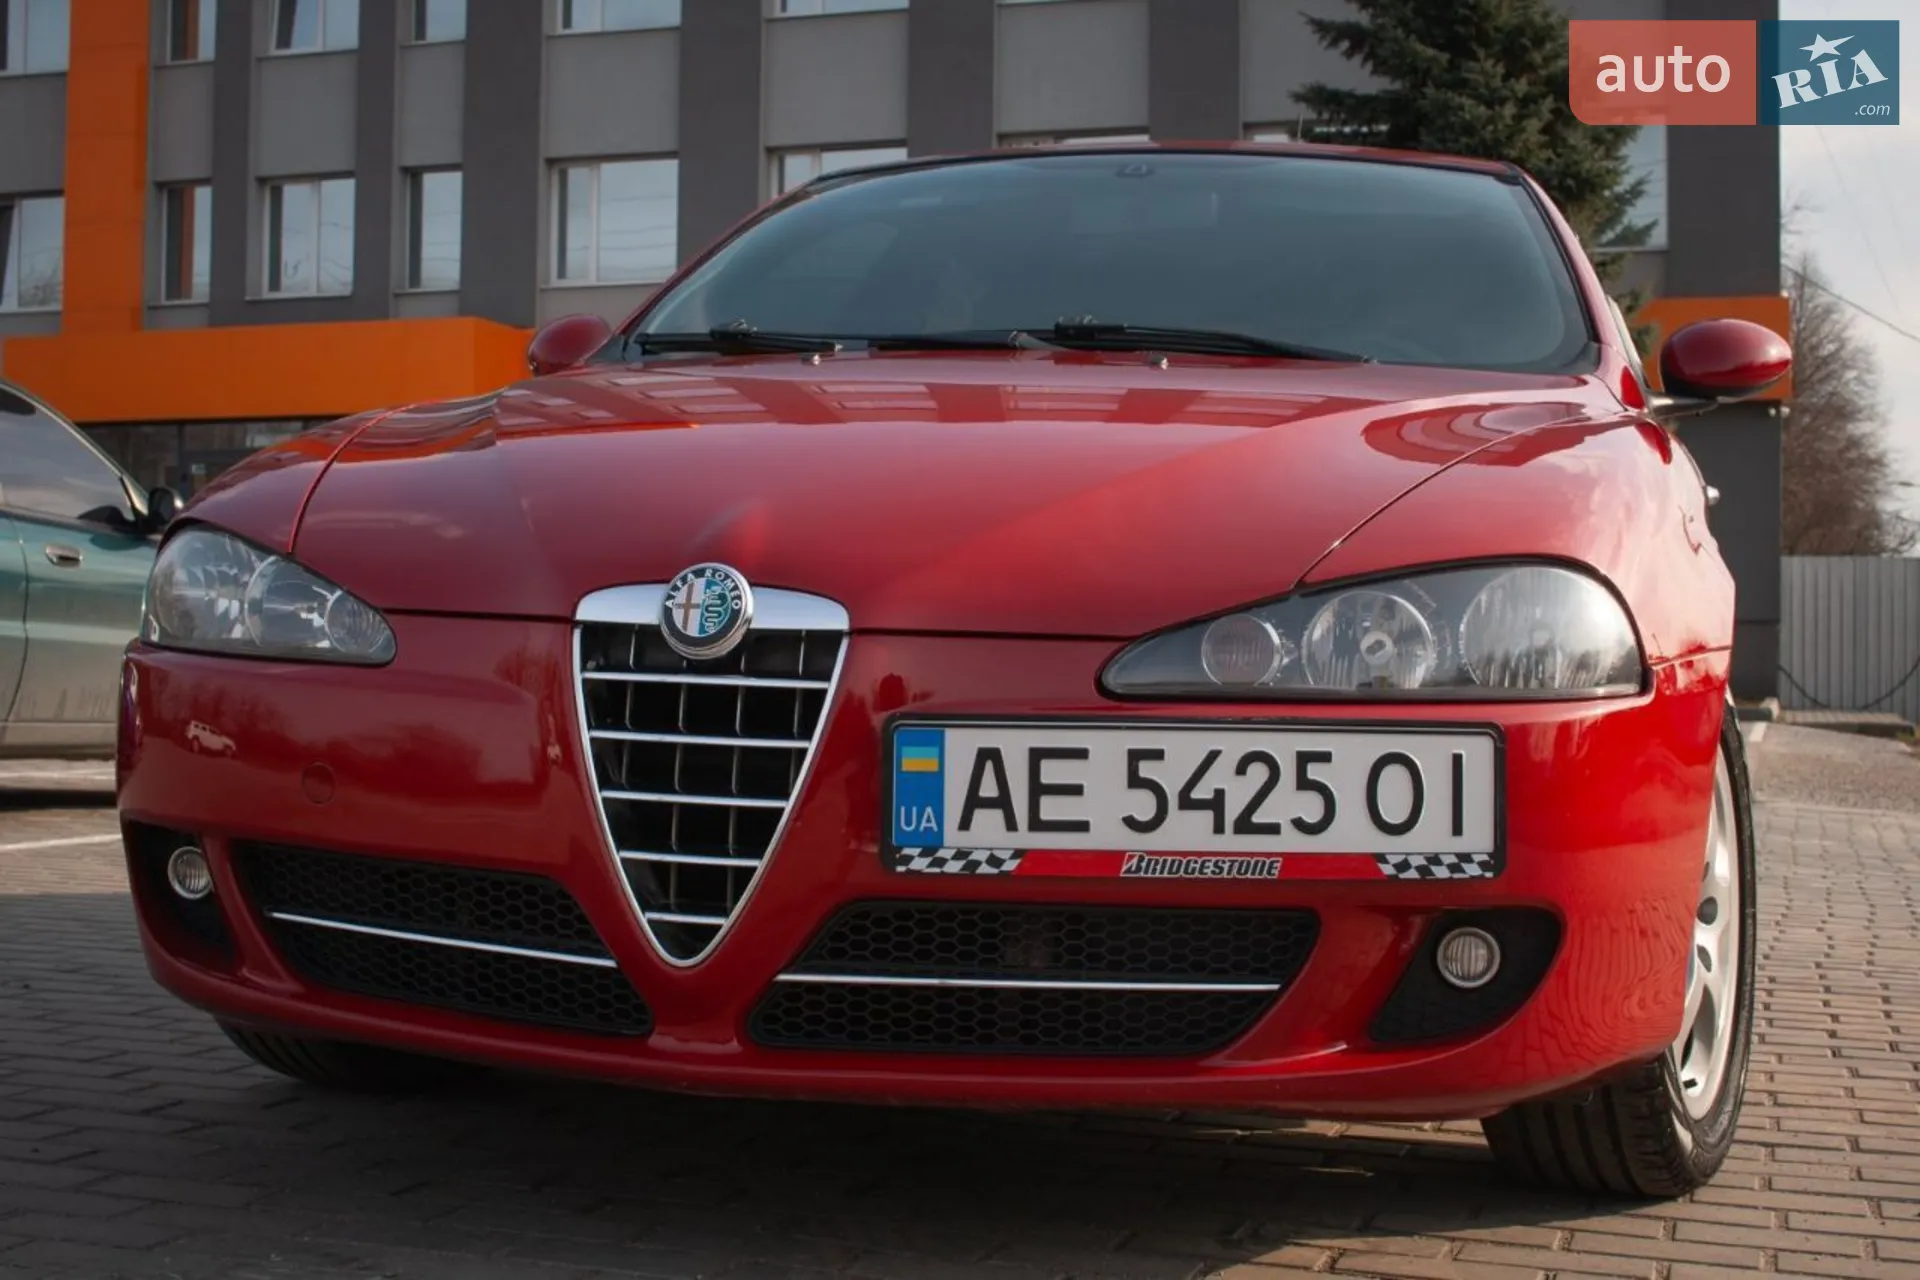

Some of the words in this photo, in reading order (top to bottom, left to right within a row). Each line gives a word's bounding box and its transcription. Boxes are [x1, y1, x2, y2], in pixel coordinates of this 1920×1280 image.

[664, 573, 696, 608] ALFA
[704, 568, 742, 610] ROMEO
[957, 746, 1091, 833] AE
[1120, 748, 1337, 835] 5425
[900, 806, 939, 833] UA
[1120, 852, 1283, 878] BRIDGESTONE
